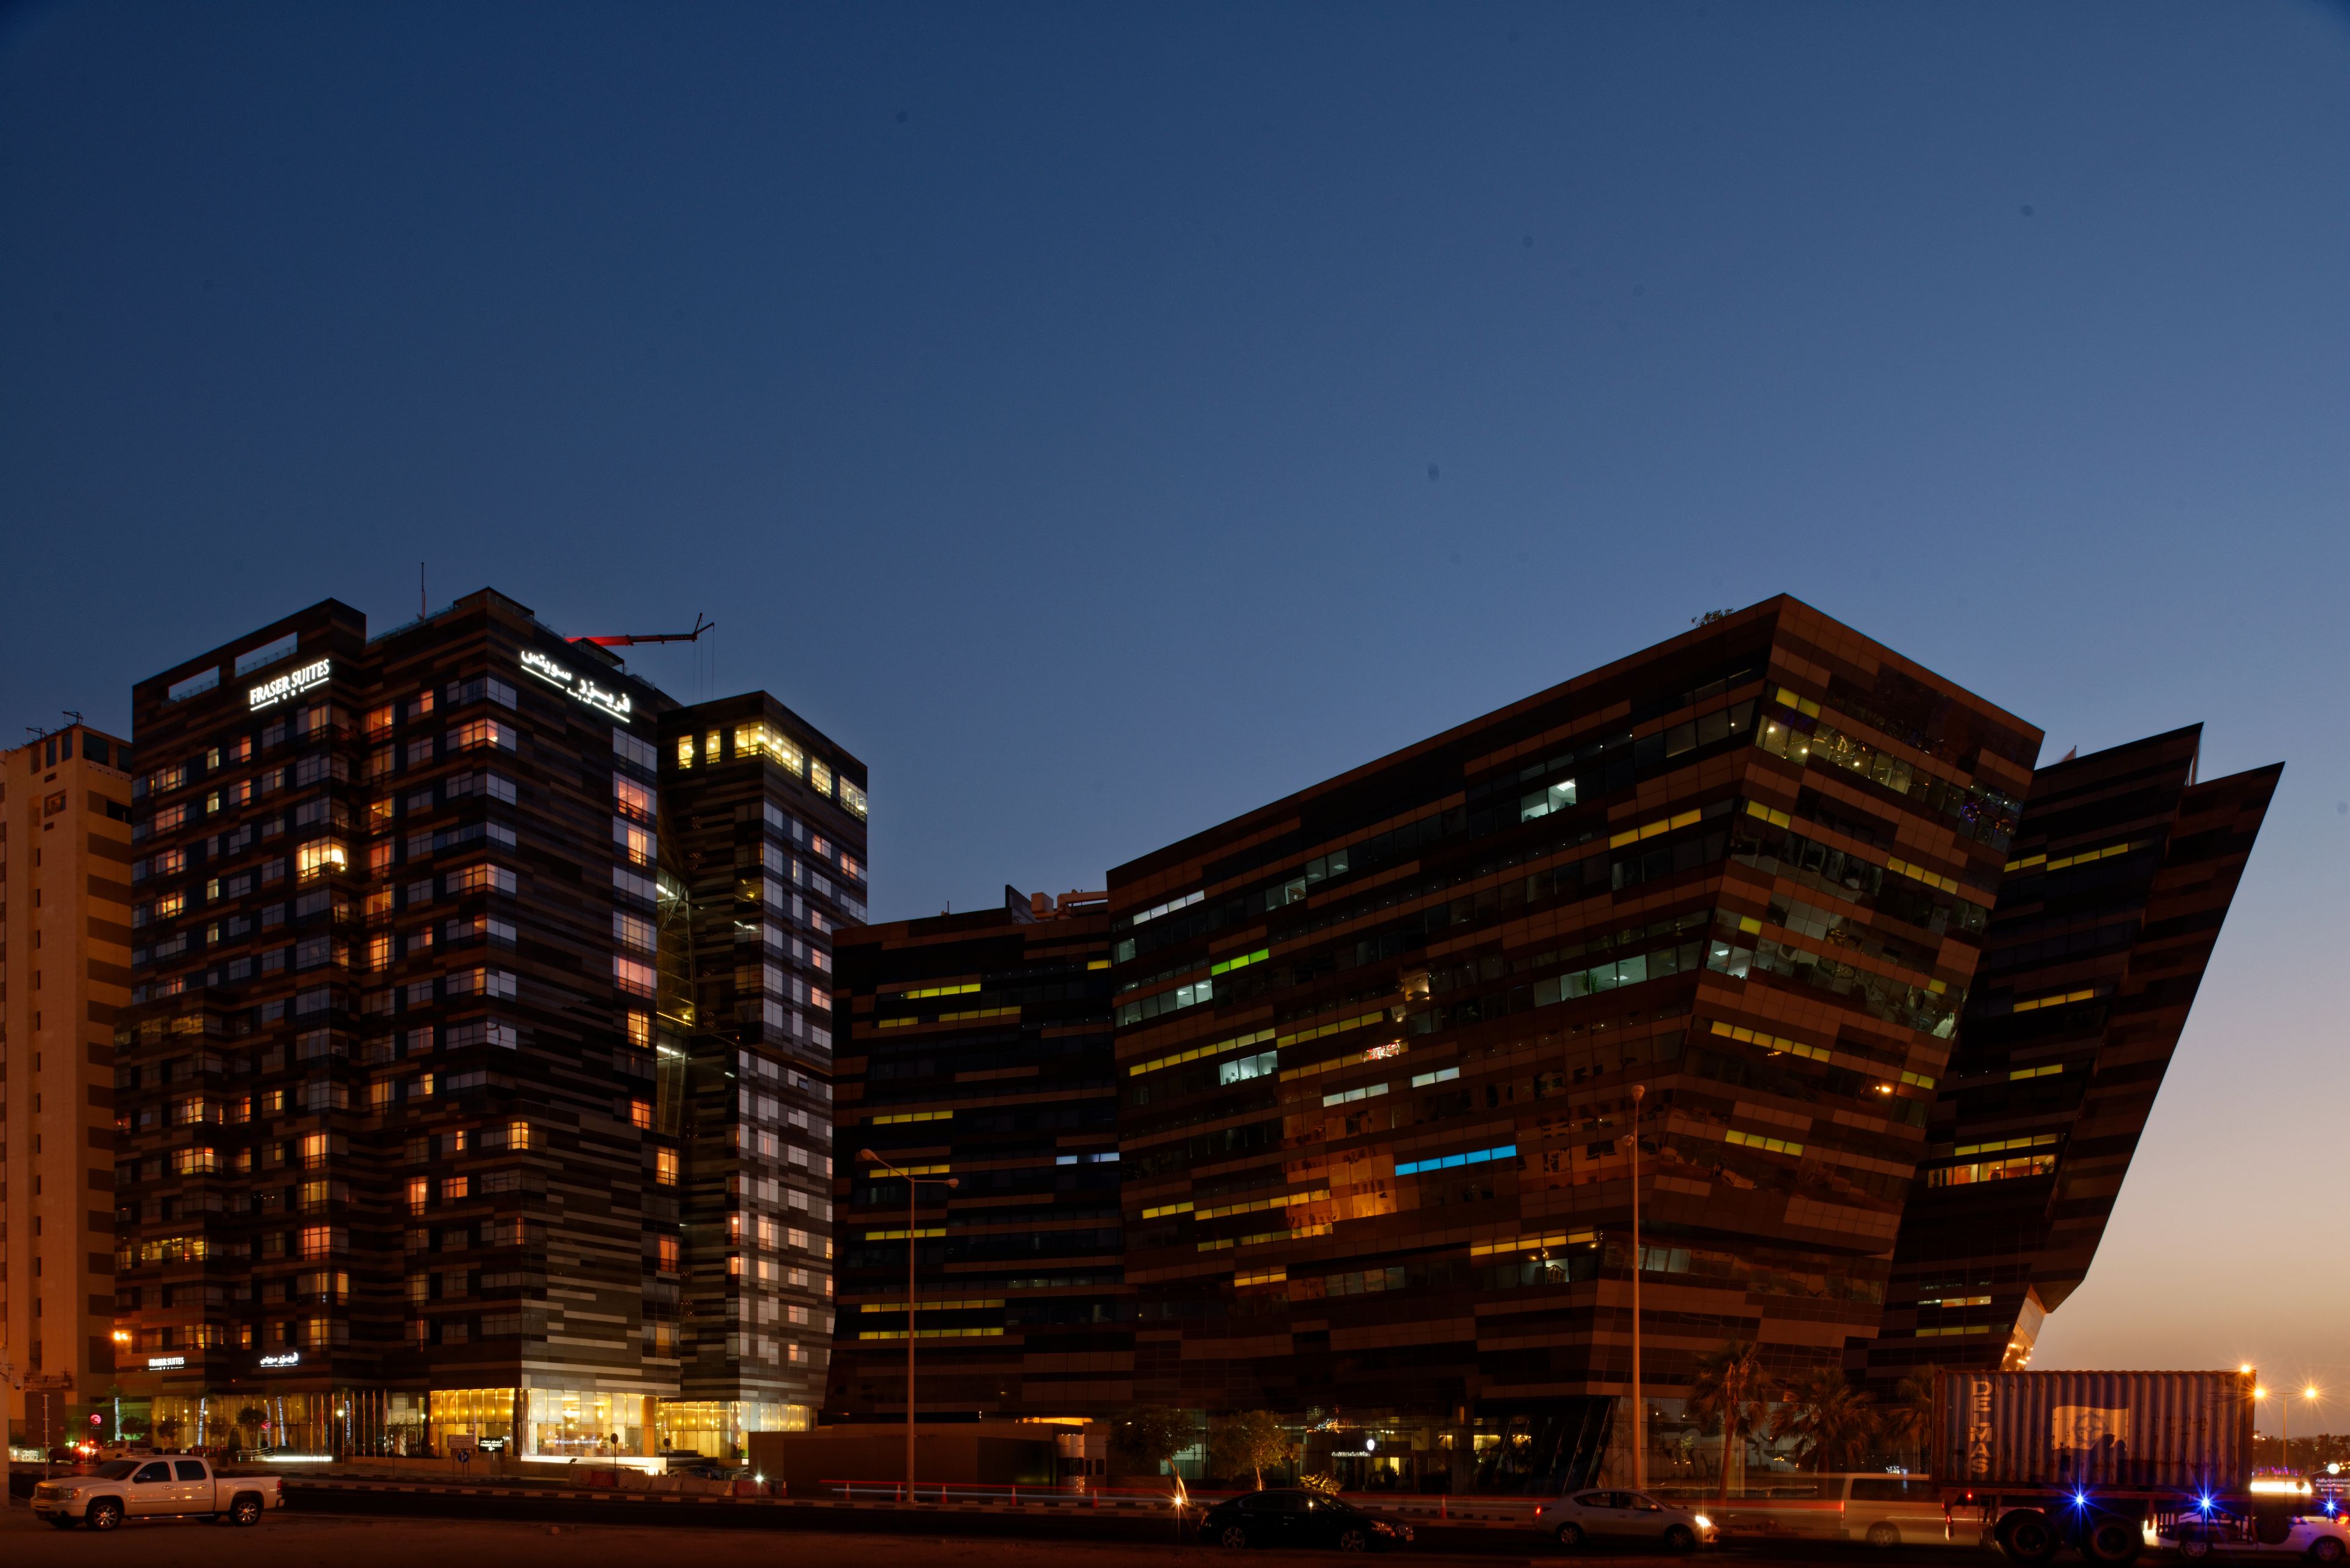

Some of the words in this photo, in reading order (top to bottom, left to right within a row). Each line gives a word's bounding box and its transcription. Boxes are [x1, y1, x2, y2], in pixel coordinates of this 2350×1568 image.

[249, 676, 291, 705] FRASER
[291, 658, 330, 688] SUITES
[521, 651, 572, 681] سويتس
[274, 686, 305, 703] DOHA
[578, 679, 630, 712] فريزر
[149, 1358, 168, 1367] FRASER
[167, 1357, 185, 1365] SUITES
[1969, 1380, 1993, 1474] DELMAS
